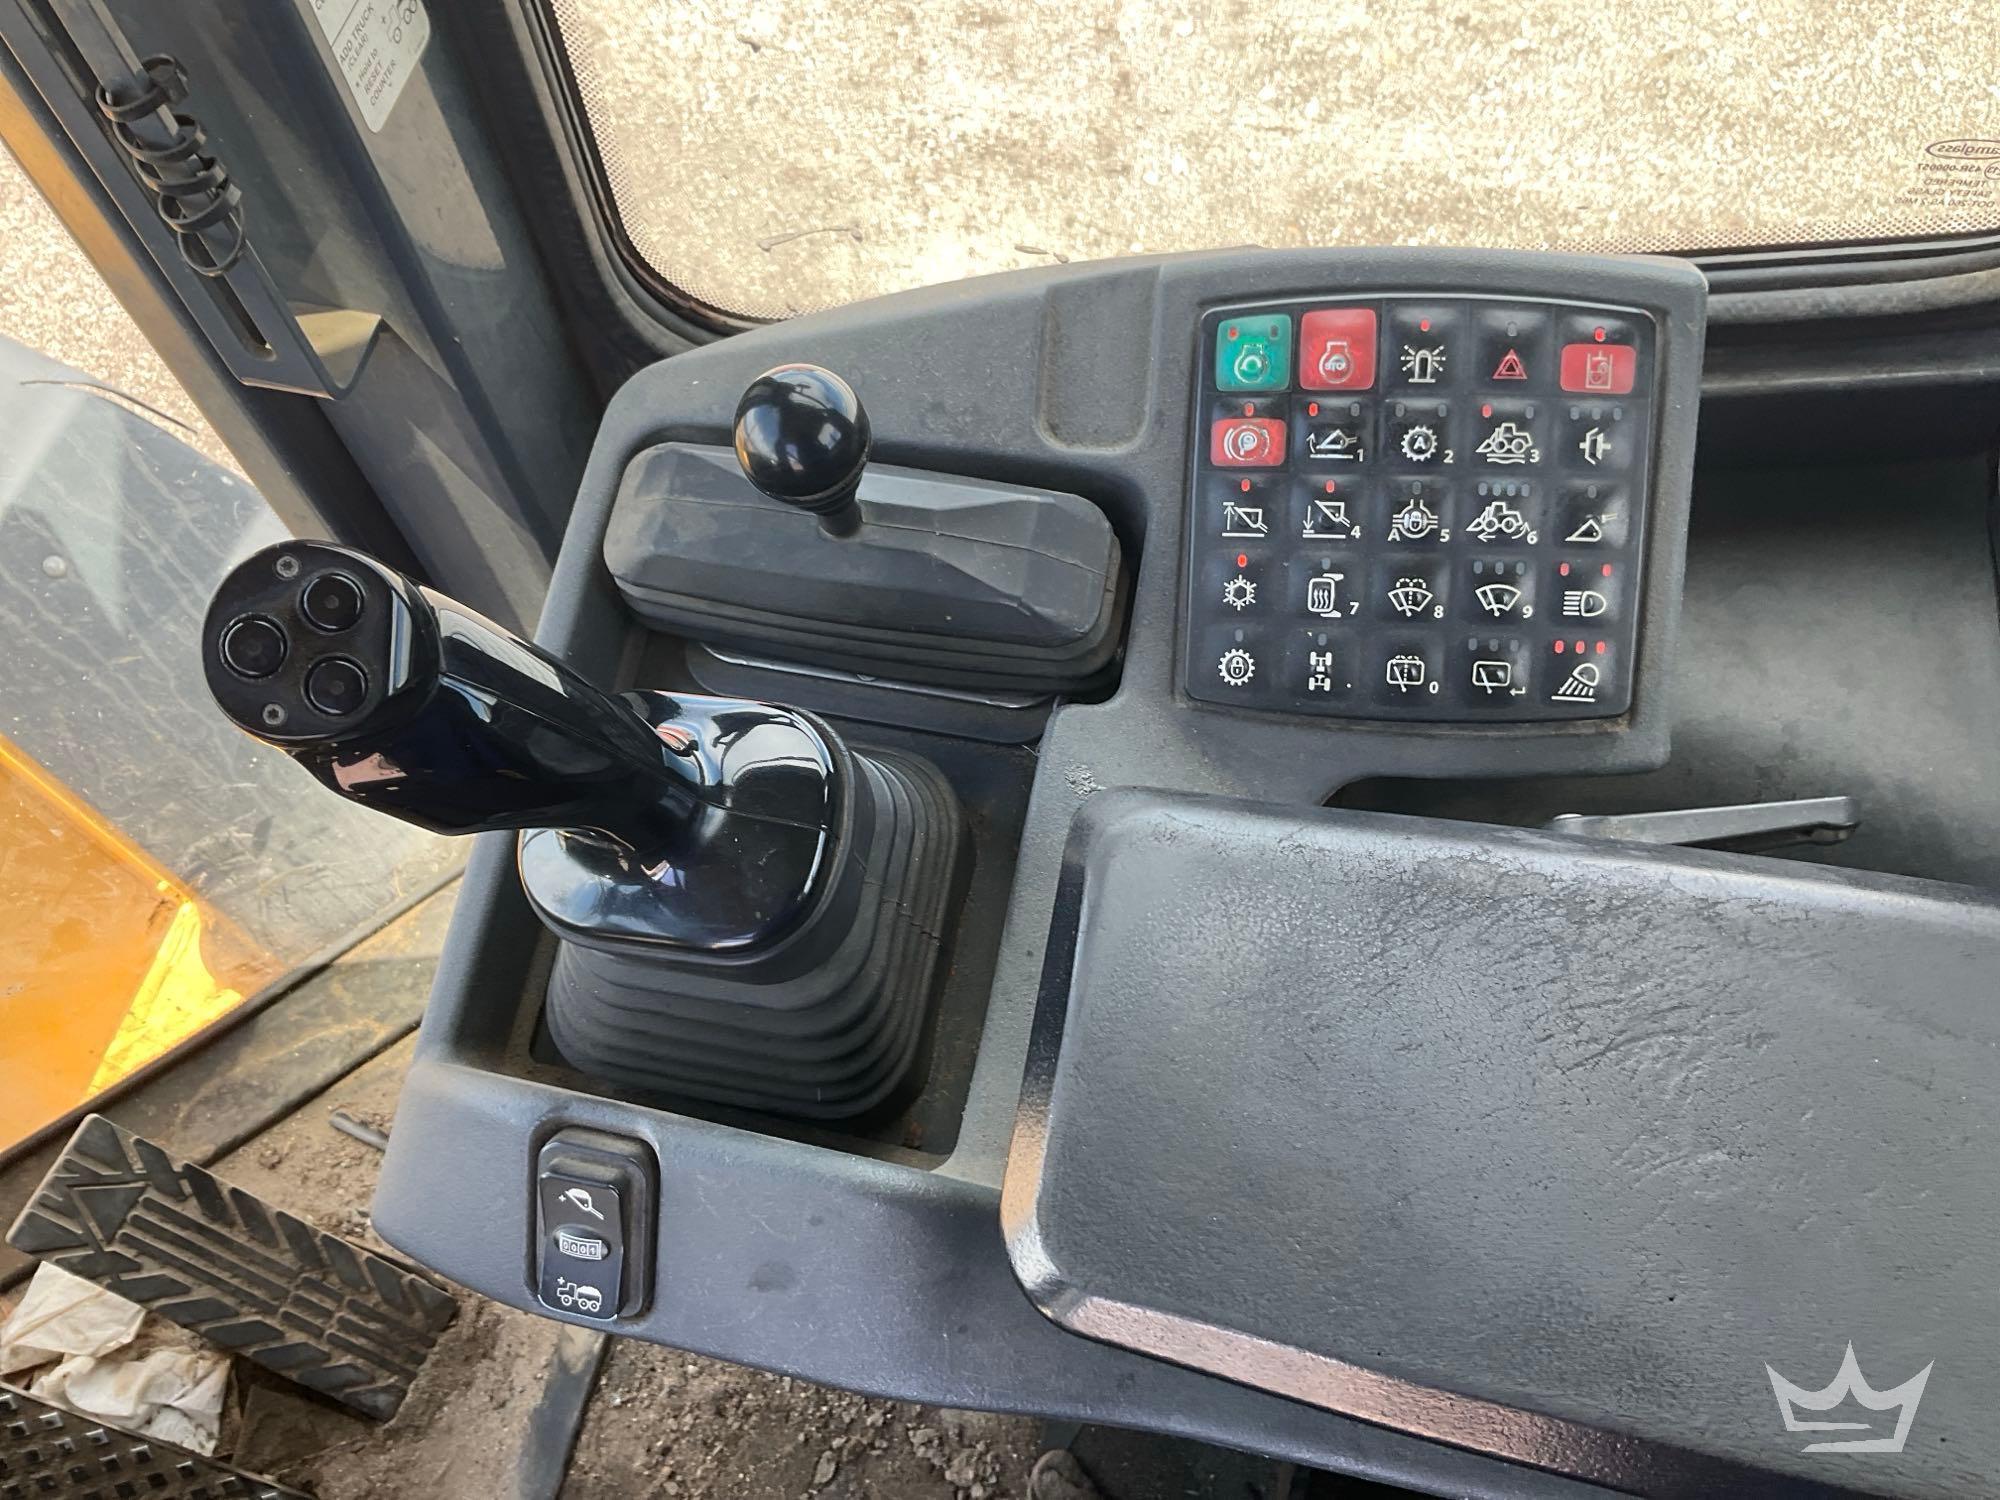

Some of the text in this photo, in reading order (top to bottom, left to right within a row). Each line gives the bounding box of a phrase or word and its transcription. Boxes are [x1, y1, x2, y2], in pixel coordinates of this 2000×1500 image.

[339, 3, 376, 64] ADD TRUCK
[358, 58, 372, 81] Hold
[364, 62, 384, 95] RESET
[369, 60, 397, 106] COUNTER
[1413, 436, 1425, 450] A
[1356, 449, 1364, 462] 1
[1444, 449, 1454, 463] 2
[1530, 449, 1541, 463] 3
[1351, 526, 1361, 539] 4
[1387, 528, 1401, 541] A
[1439, 528, 1450, 542] 5
[1527, 530, 1538, 544] 6
[1349, 602, 1359, 615] 7
[1434, 605, 1444, 618] 8
[1523, 605, 1534, 618] 9
[1429, 681, 1439, 694] 0
